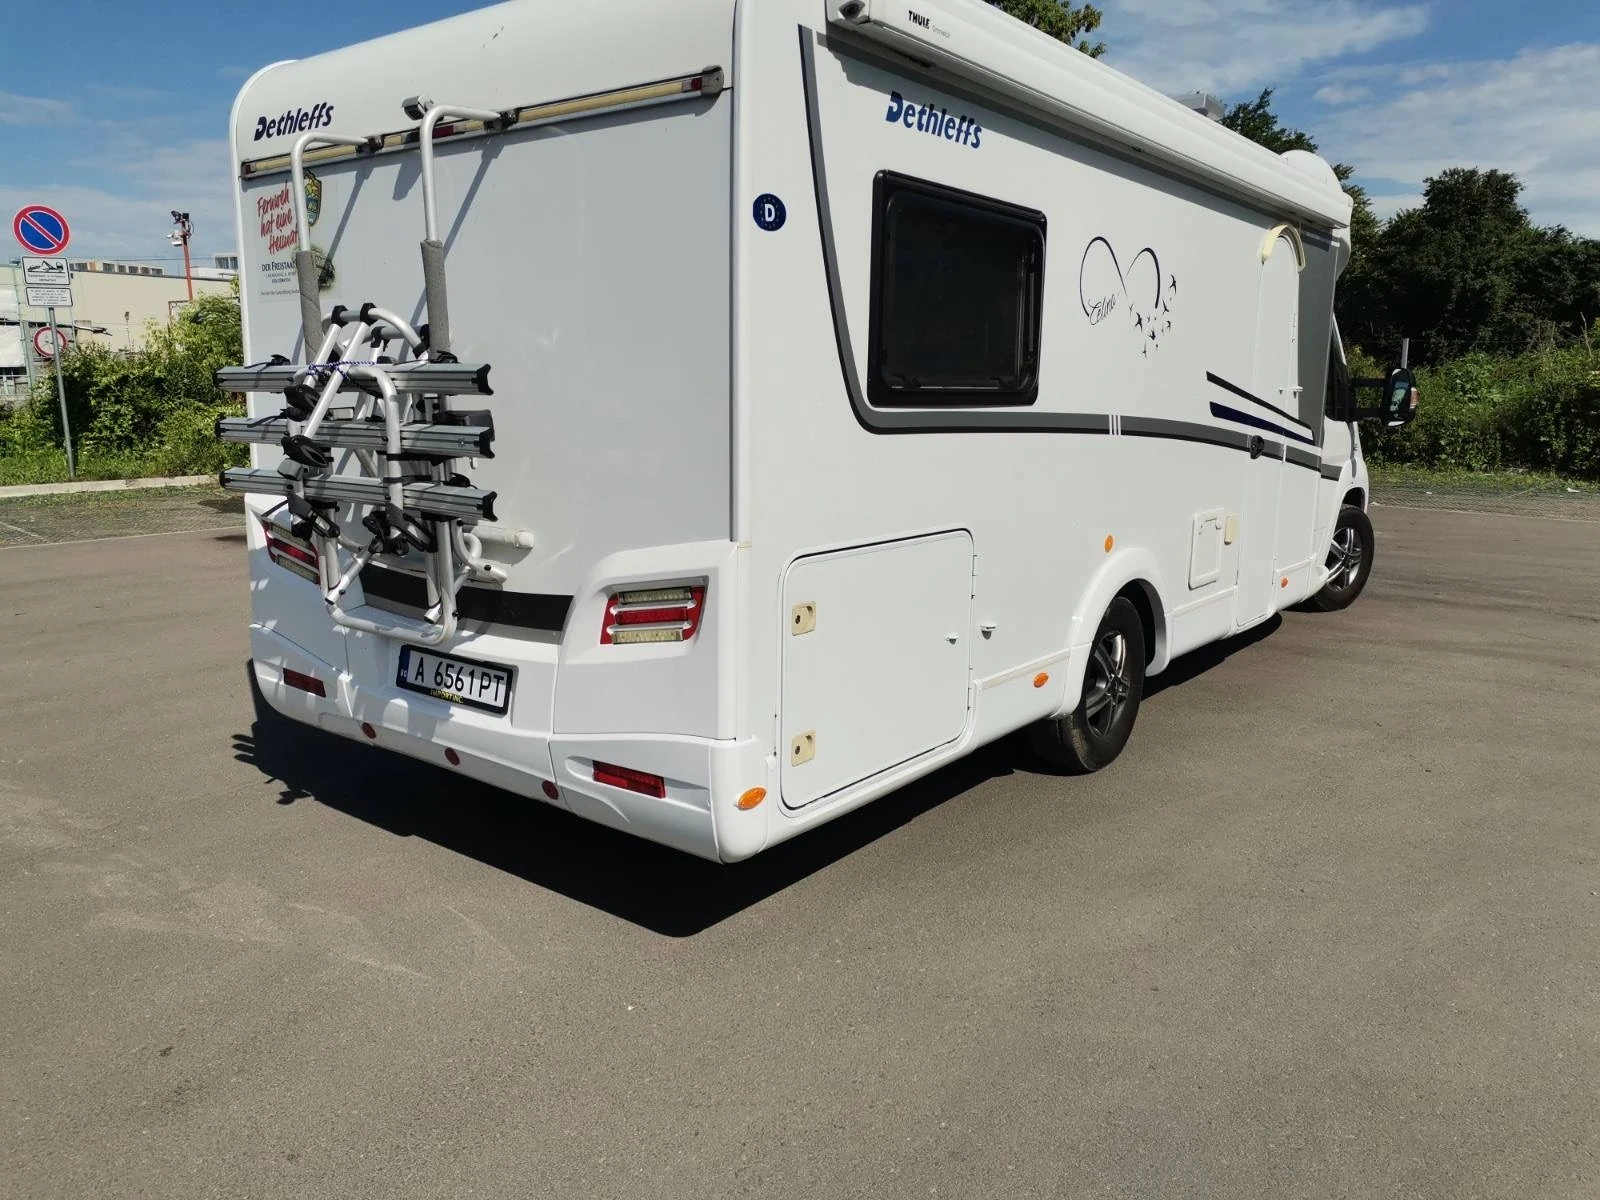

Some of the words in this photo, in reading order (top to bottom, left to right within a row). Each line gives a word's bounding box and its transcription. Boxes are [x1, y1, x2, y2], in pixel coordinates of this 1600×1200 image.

[908, 10, 930, 29] THULE
[254, 102, 334, 141] Dethleffs
[886, 91, 982, 149] Dethleffs
[257, 179, 290, 217] Fernweh
[764, 203, 775, 222] D
[261, 213, 275, 238] hat
[276, 207, 292, 231] eine
[415, 656, 424, 683] A
